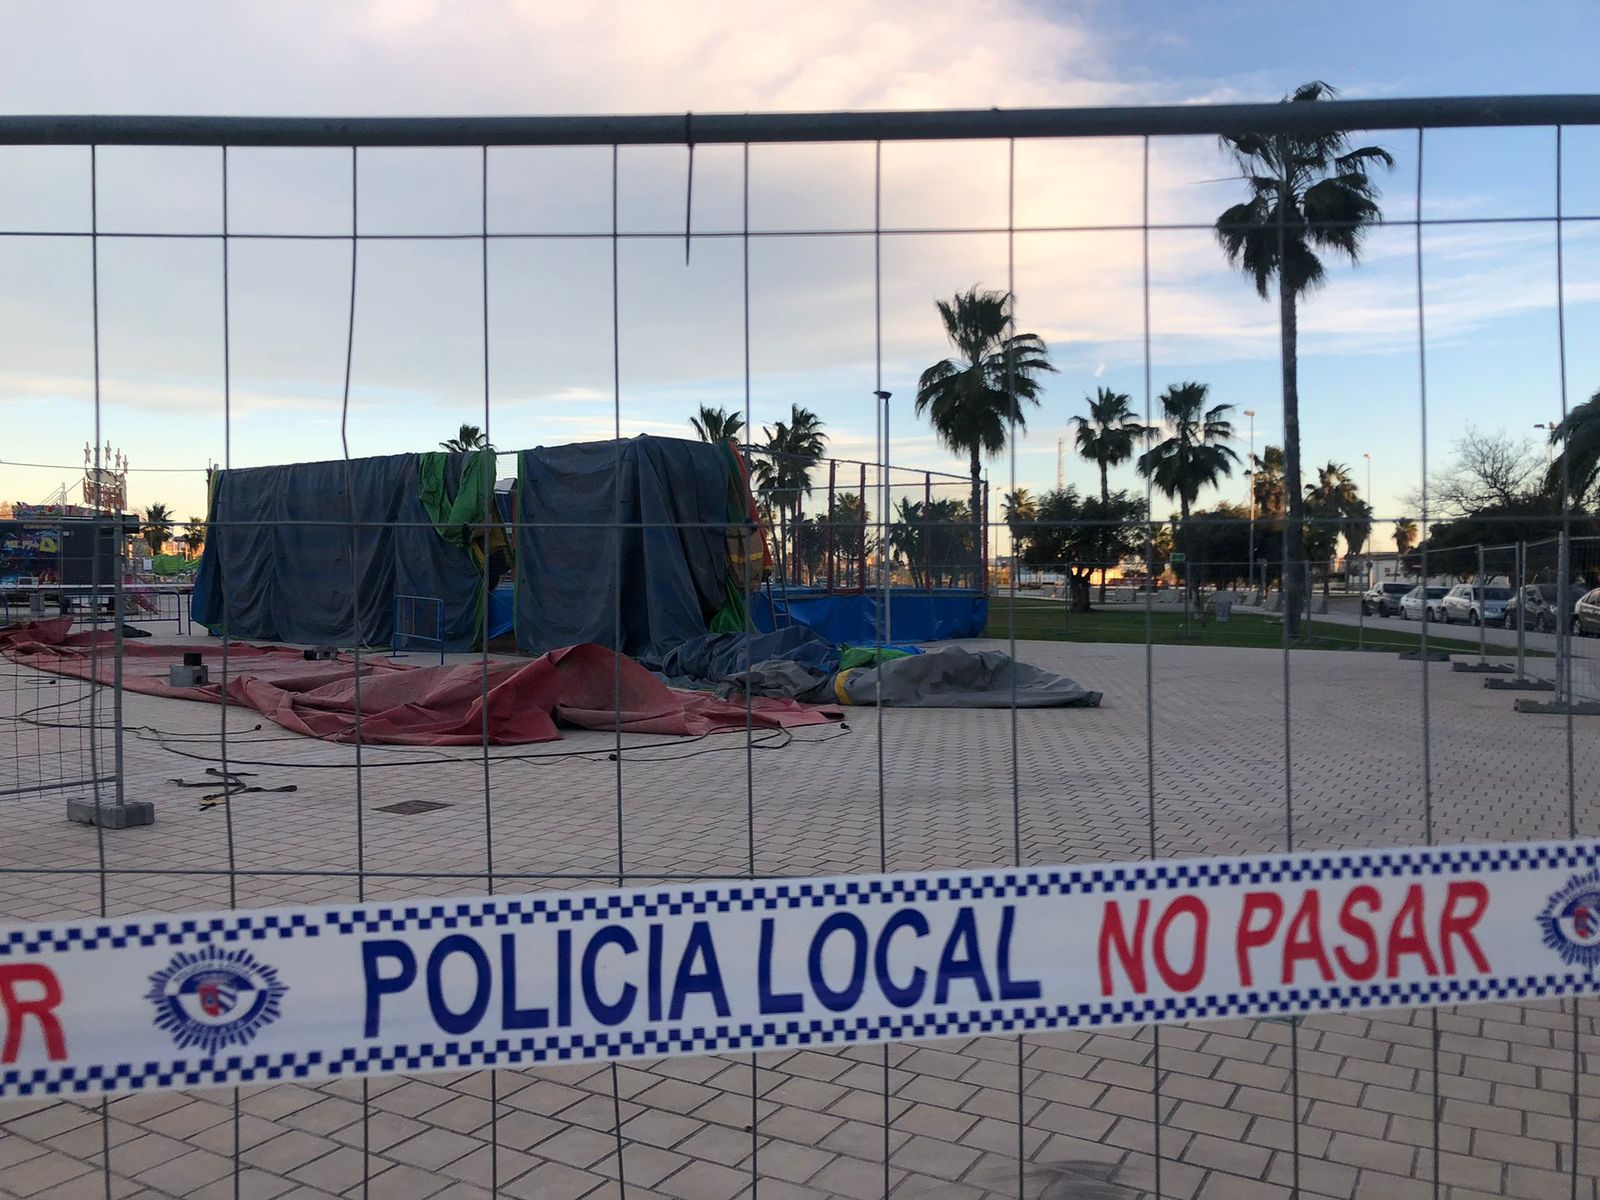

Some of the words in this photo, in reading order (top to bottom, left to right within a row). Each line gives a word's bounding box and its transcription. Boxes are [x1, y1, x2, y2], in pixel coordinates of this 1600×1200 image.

[361, 920, 731, 1039] POLICIA
[757, 905, 1042, 1015] LOCAL
[1098, 895, 1209, 997] NO
[1236, 880, 1491, 987] PASAR
